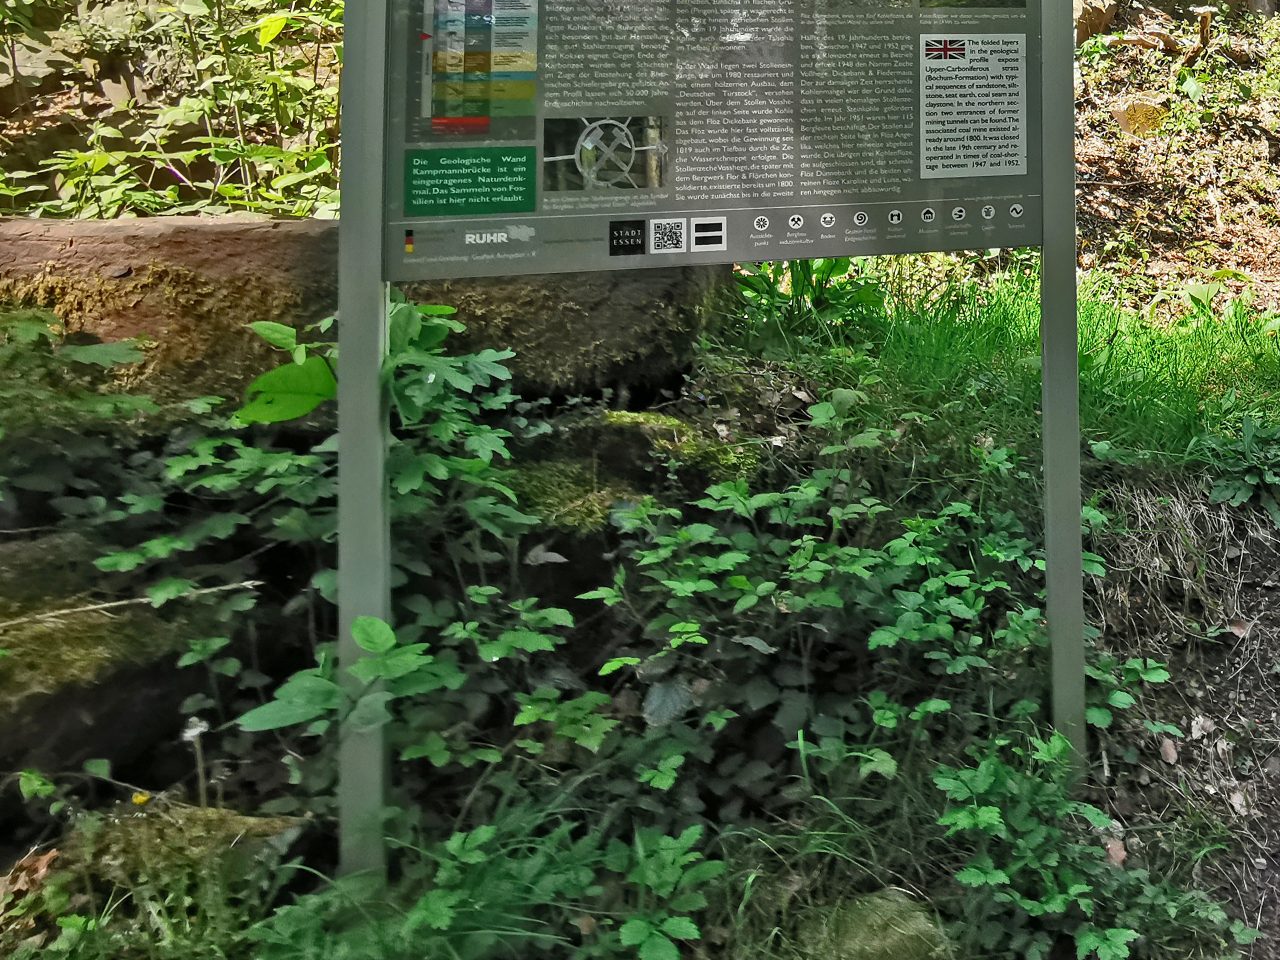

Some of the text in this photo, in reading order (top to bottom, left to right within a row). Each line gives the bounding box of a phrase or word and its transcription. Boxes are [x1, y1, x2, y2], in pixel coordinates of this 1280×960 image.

[1002, 39, 1018, 48] layers
[990, 48, 1018, 56] geological
[925, 66, 989, 75] Upper-Carboniferous
[925, 74, 988, 82] (Bochum-Formation)
[1005, 74, 1018, 82] typi-
[925, 101, 955, 109] claystone.
[440, 157, 491, 165] Geologische
[413, 166, 491, 176] Kampmannbrücke
[412, 175, 526, 186] eingetragenes Naturdenk-
[692, 174, 724, 182] Bergwerk
[469, 195, 490, 203] nicht
[613, 229, 641, 237] STADT
[465, 232, 508, 244] RUHR
